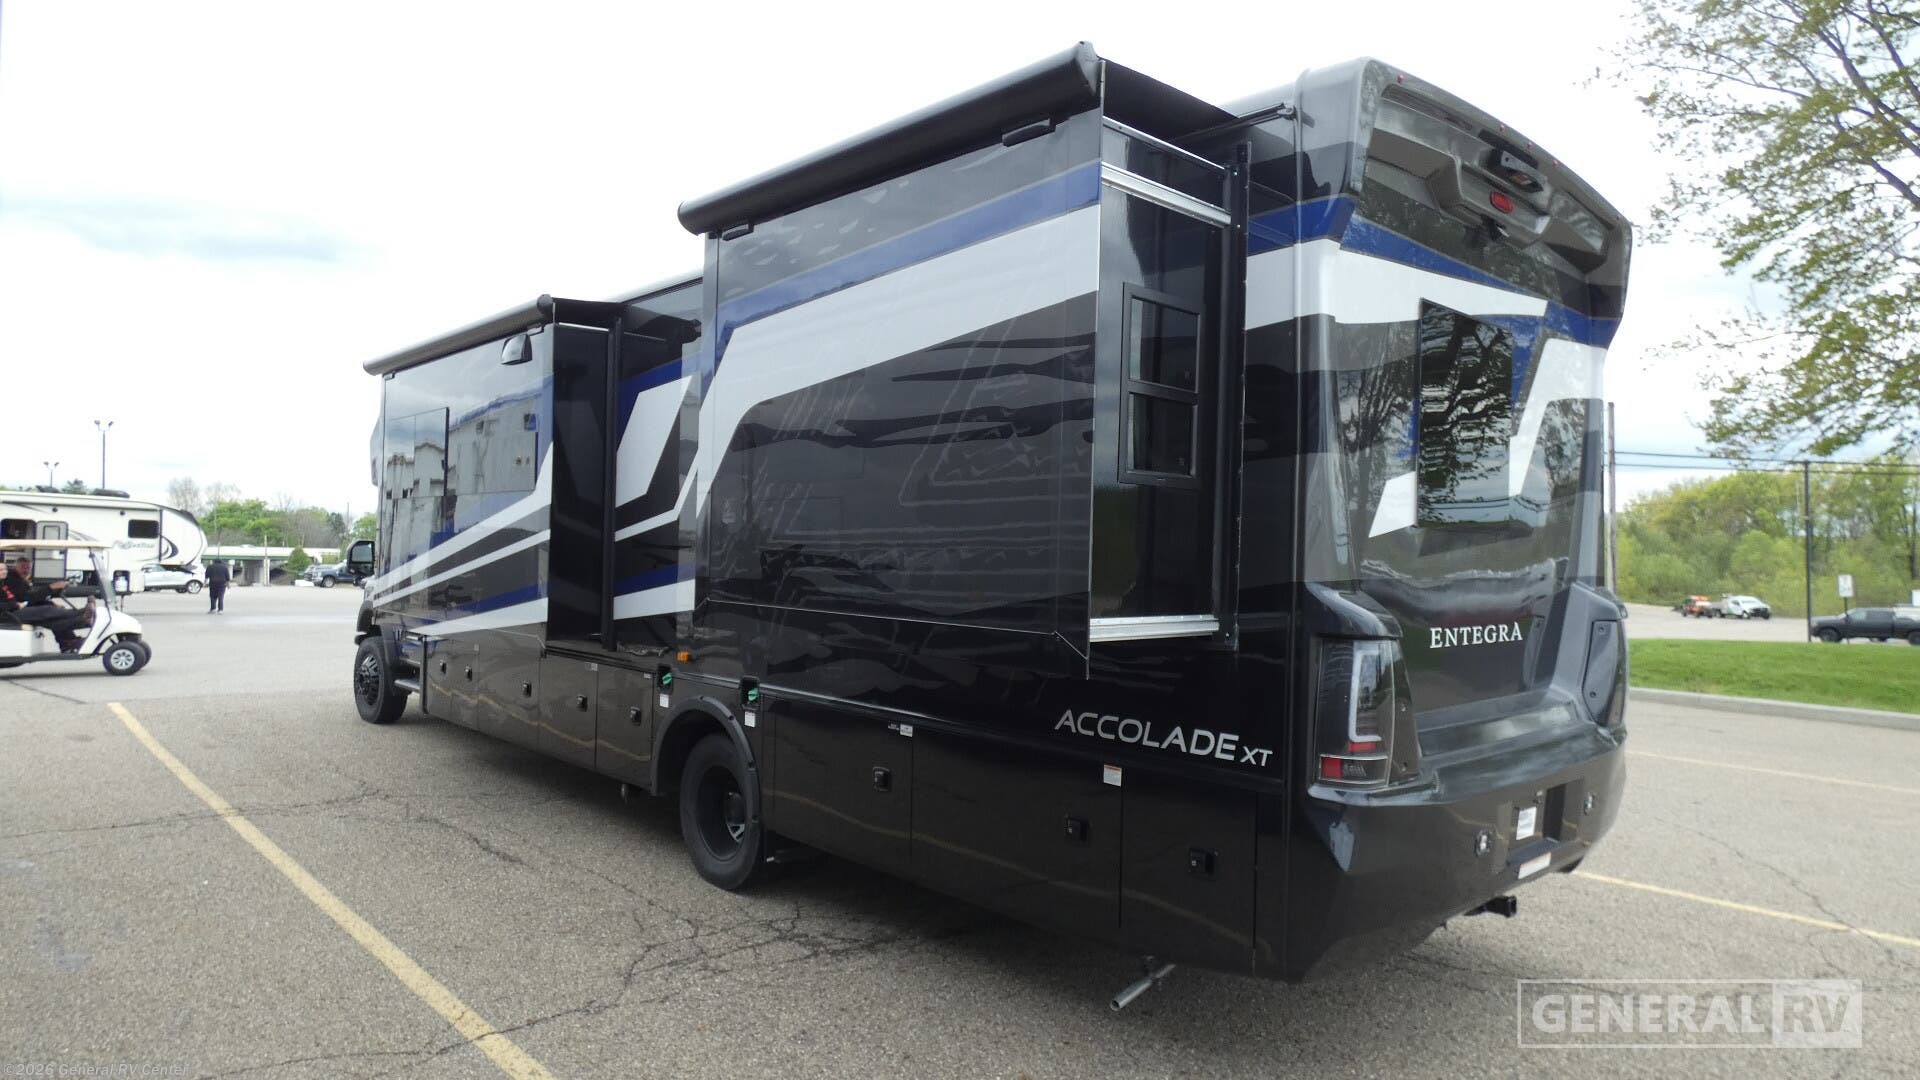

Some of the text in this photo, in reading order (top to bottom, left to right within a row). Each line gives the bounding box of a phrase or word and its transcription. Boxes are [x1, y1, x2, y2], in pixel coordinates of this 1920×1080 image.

[1429, 621, 1523, 649] ENTEGRA
[1054, 709, 1273, 767] ACCOLADE XT
